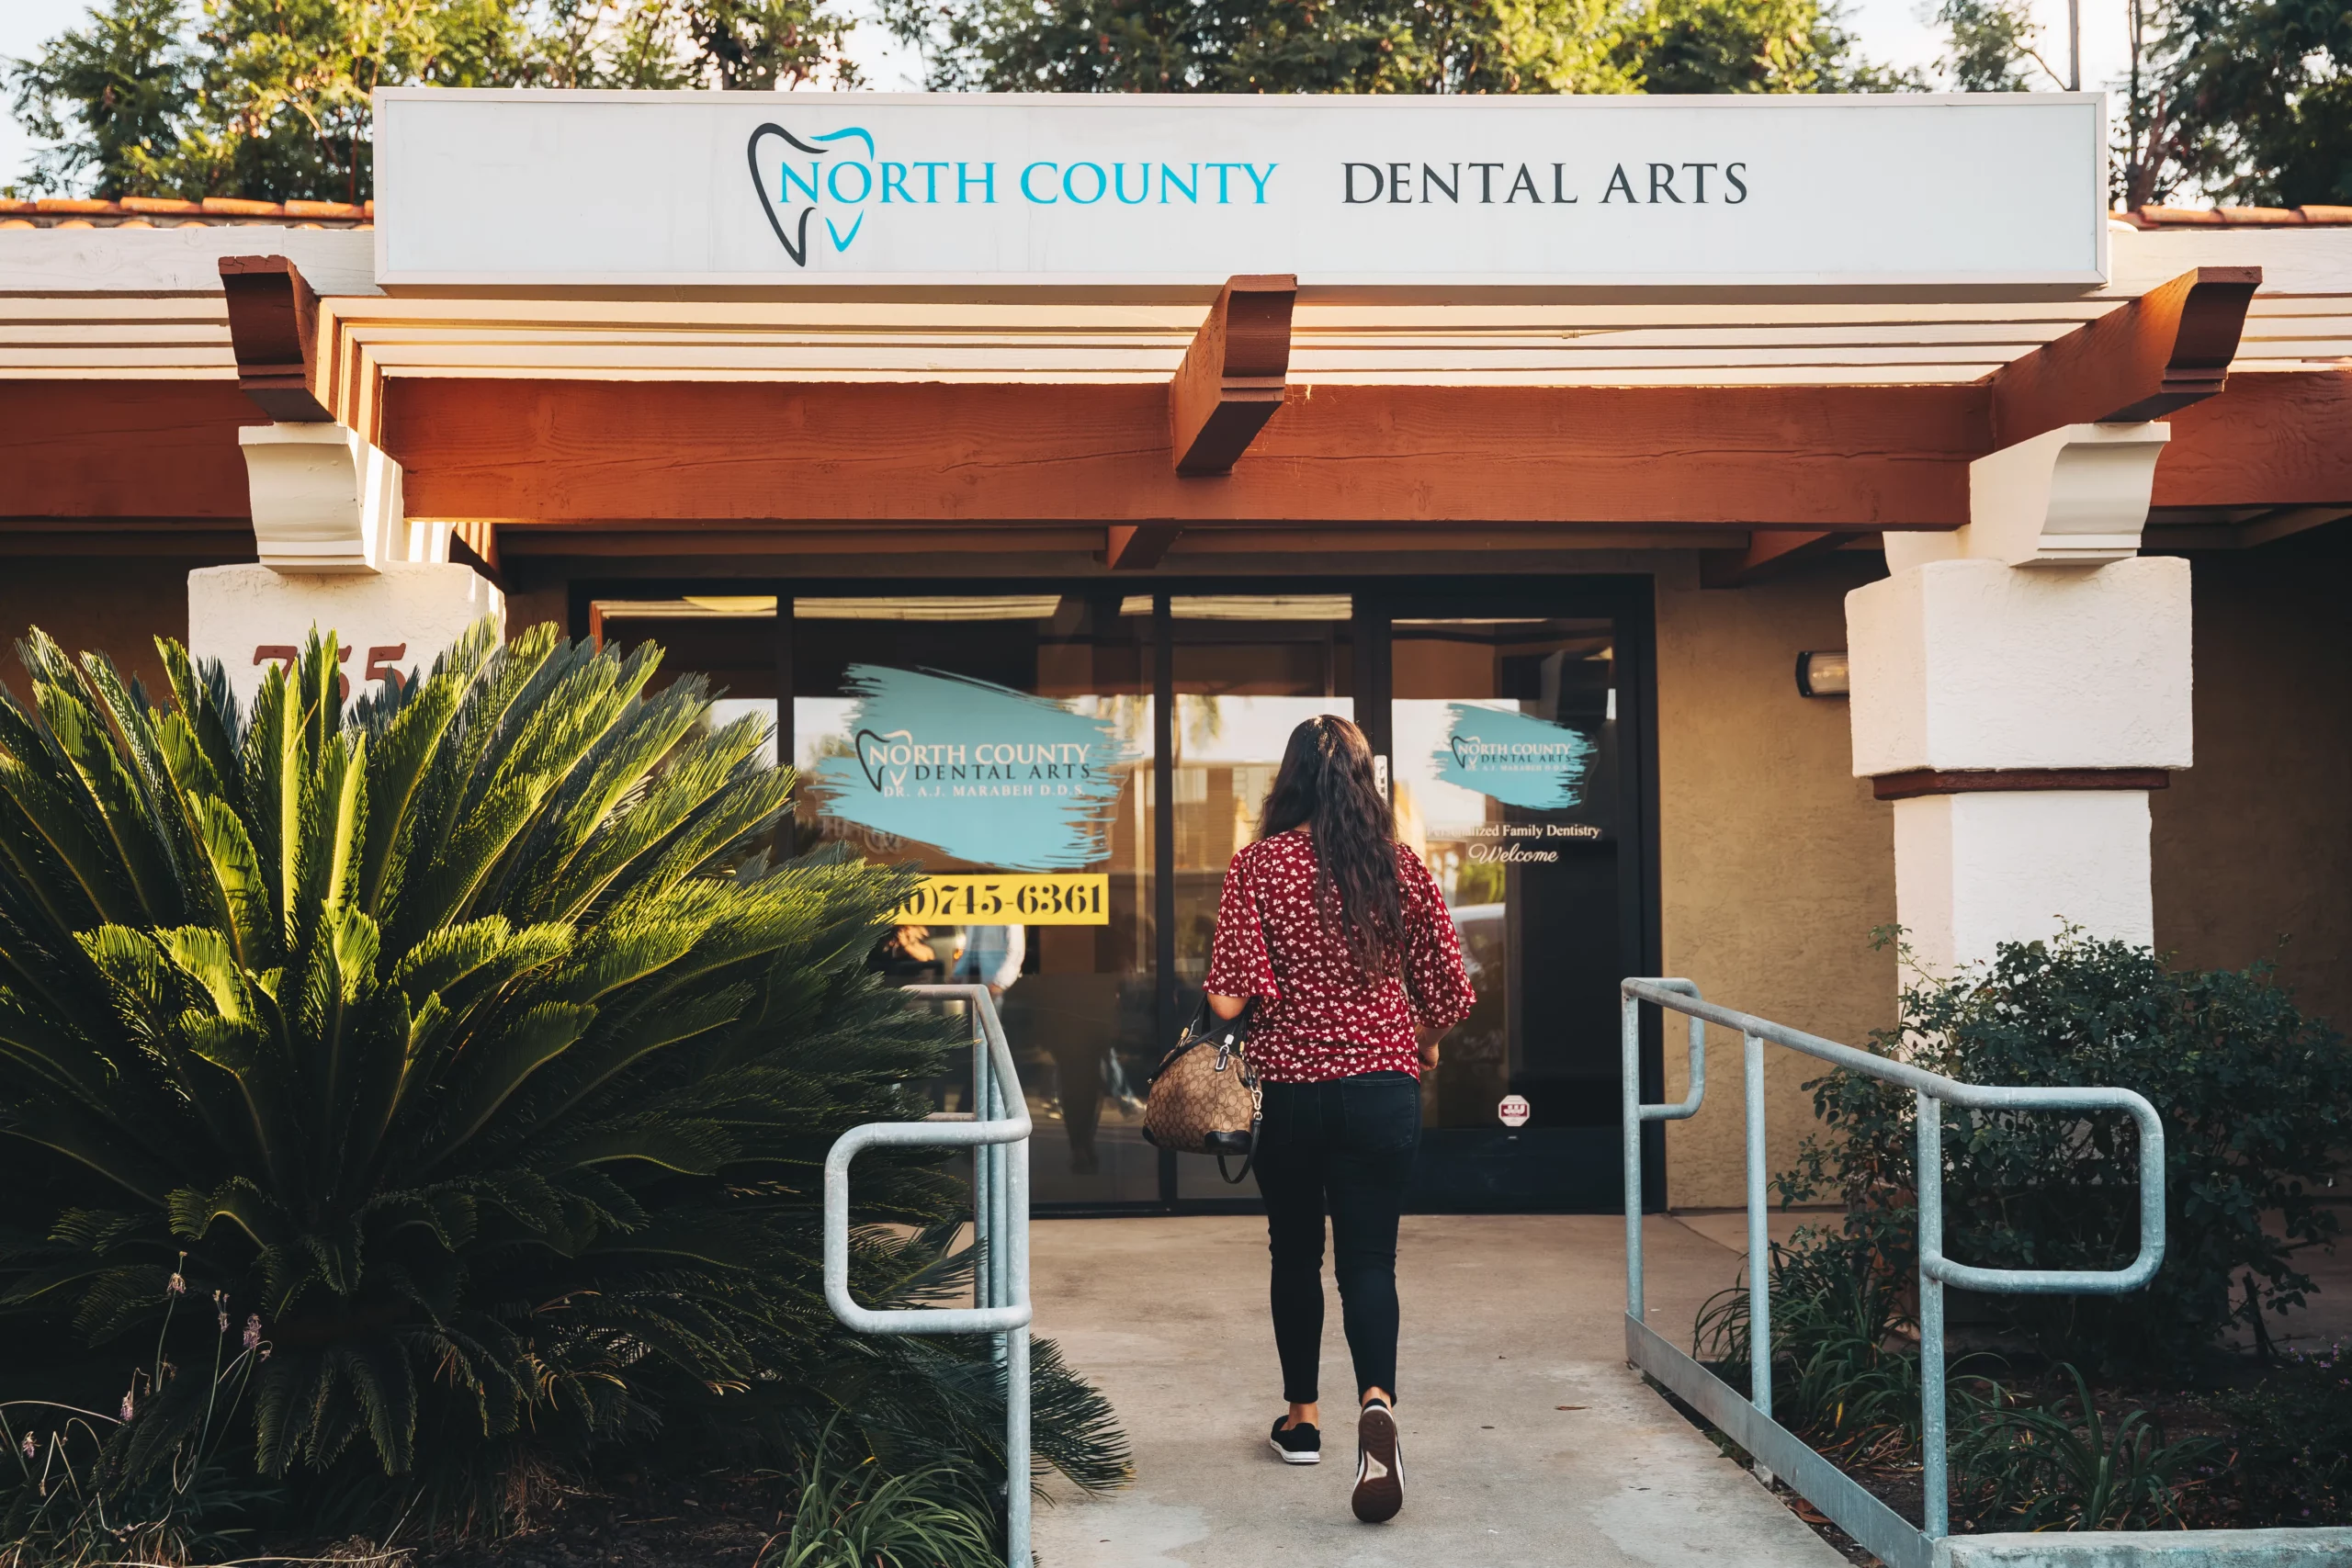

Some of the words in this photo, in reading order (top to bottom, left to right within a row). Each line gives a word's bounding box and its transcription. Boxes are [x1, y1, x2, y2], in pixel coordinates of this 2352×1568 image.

[777, 160, 996, 205] NORTH
[1021, 160, 1278, 205] COUNTY
[1342, 162, 1577, 205] DENTAL
[1600, 162, 1749, 205] ARTS
[869, 745, 966, 765] NORTH
[975, 744, 1091, 764] COUNTY
[1458, 743, 1508, 755] NORTH
[1512, 742, 1571, 755] COUNTY
[1481, 754, 1532, 762] DENTAL
[1539, 753, 1571, 762] ARTS
[915, 764, 1017, 781] DENTAL
[1028, 763, 1091, 780] ARTS
[884, 786, 910, 797] DR.
[953, 785, 1033, 797] MARABEH
[1502, 825, 1544, 839] Family
[1546, 825, 1600, 839] Dentistry
[1468, 843, 1559, 864] Welcome
[894, 883, 1102, 919] 0)745-6361
